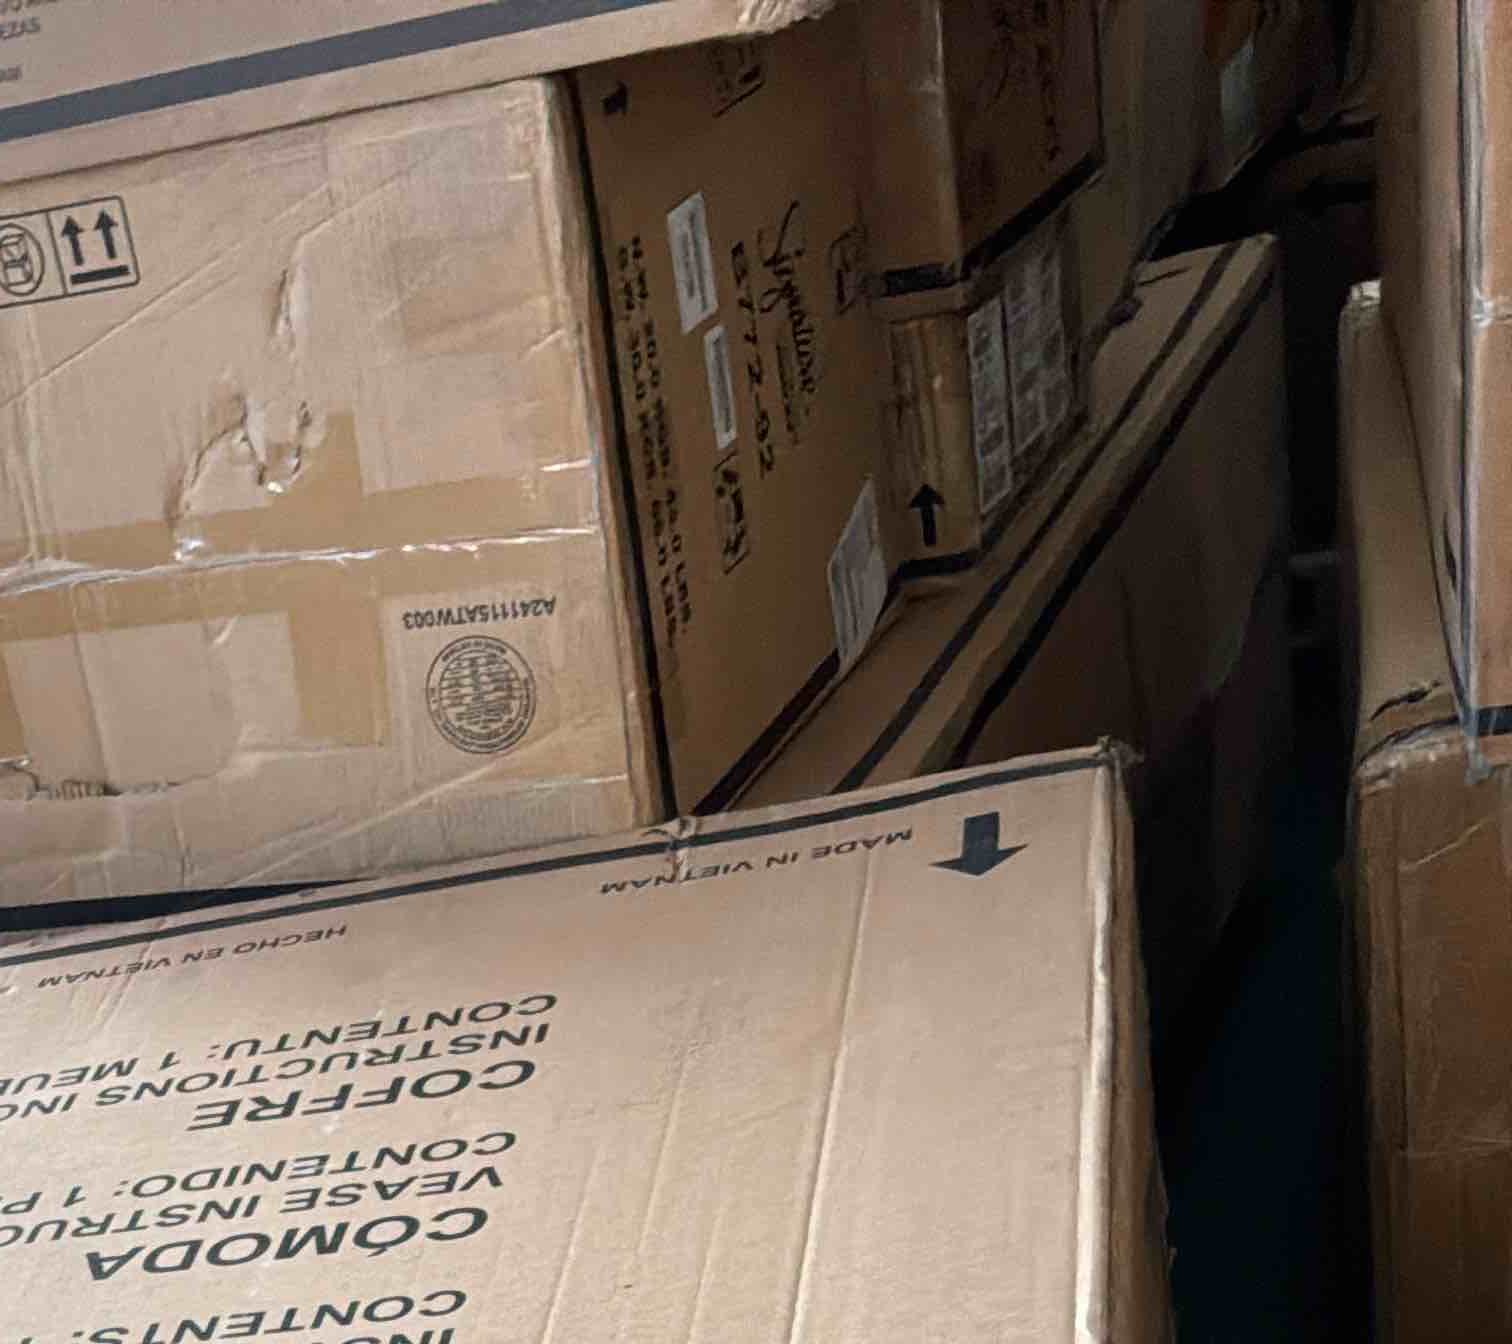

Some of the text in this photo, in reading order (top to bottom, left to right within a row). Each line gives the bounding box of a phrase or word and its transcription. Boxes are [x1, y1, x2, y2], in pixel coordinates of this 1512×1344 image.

[599, 827, 913, 895] MADE IN VIETNAM
[35, 923, 348, 989] HECHO EN VIETNAM
[208, 992, 560, 1063] CONTENTU:
[98, 1023, 554, 1108] INSTRUCTIONS
[158, 1051, 184, 1075] 1
[186, 1058, 537, 1132] COFFRE
[62, 1184, 88, 1207] 1
[111, 1130, 518, 1200] CONTENIDO:
[276, 1164, 504, 1212] VEASE
[83, 1205, 491, 1282] CÓMODA
